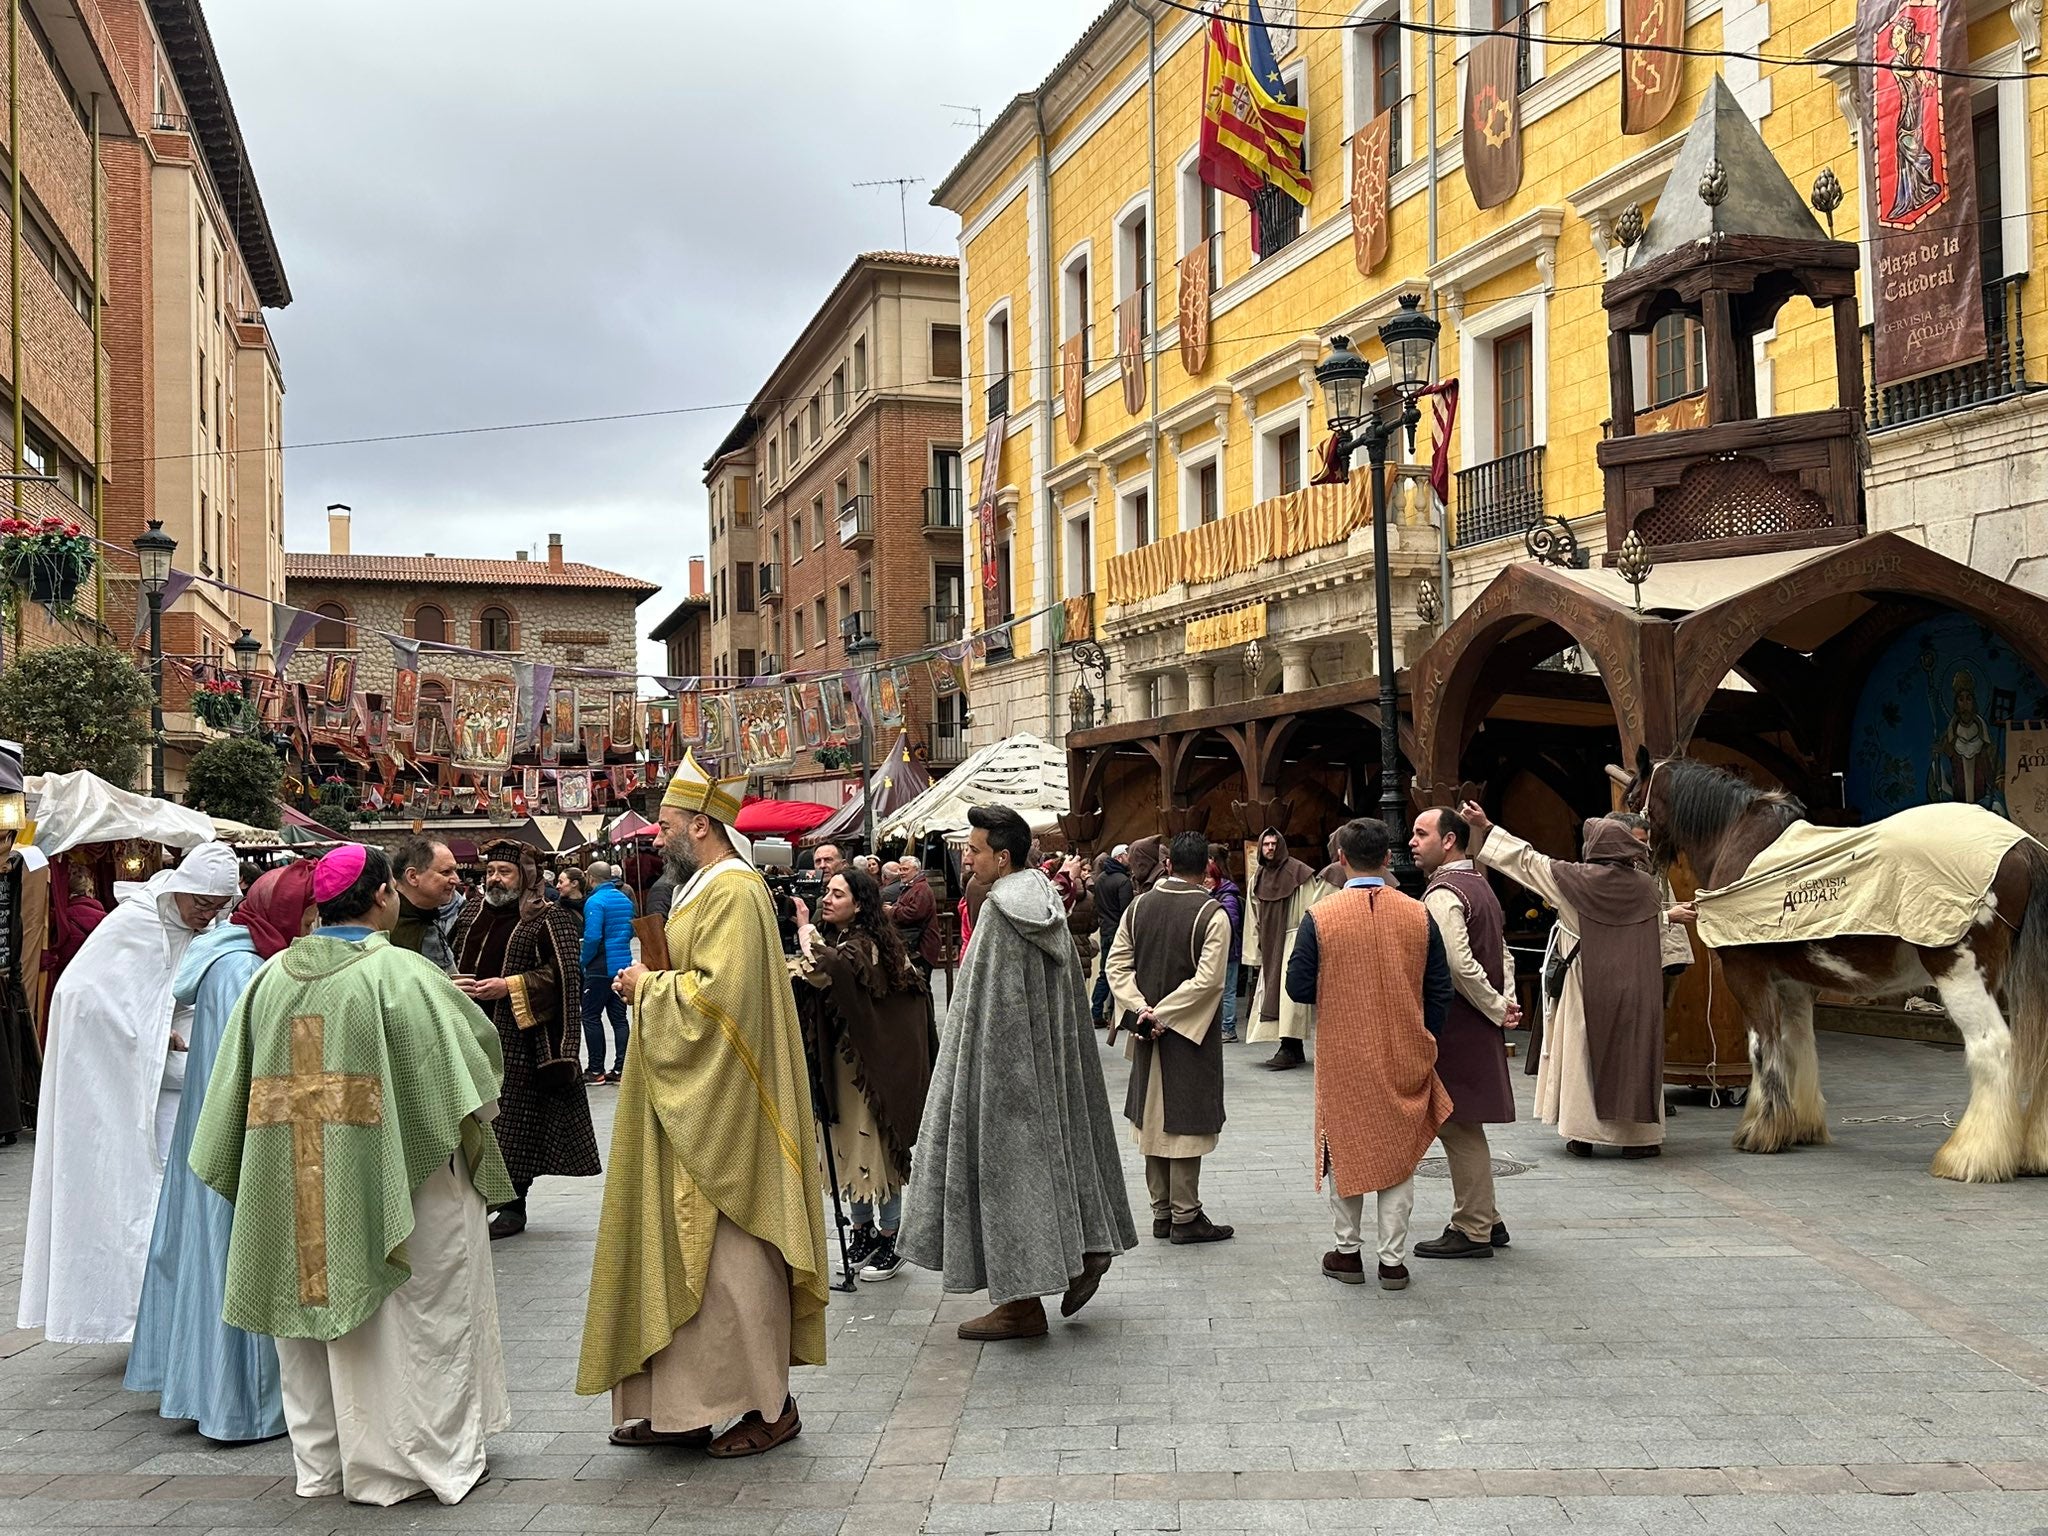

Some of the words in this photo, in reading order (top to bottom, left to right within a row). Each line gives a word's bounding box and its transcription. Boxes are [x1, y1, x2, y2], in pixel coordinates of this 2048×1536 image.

[1878, 250, 1918, 278] Plaza
[1920, 243, 1940, 262] de
[1943, 236, 1960, 257] la
[1884, 263, 1956, 302] Catedral
[1883, 310, 1933, 334] CERVISIA
[1902, 317, 1965, 365] AMBAR
[2010, 754, 2048, 784] AM
[1799, 876, 1848, 891] CERVISIA
[1778, 887, 1839, 927] AMBAR
